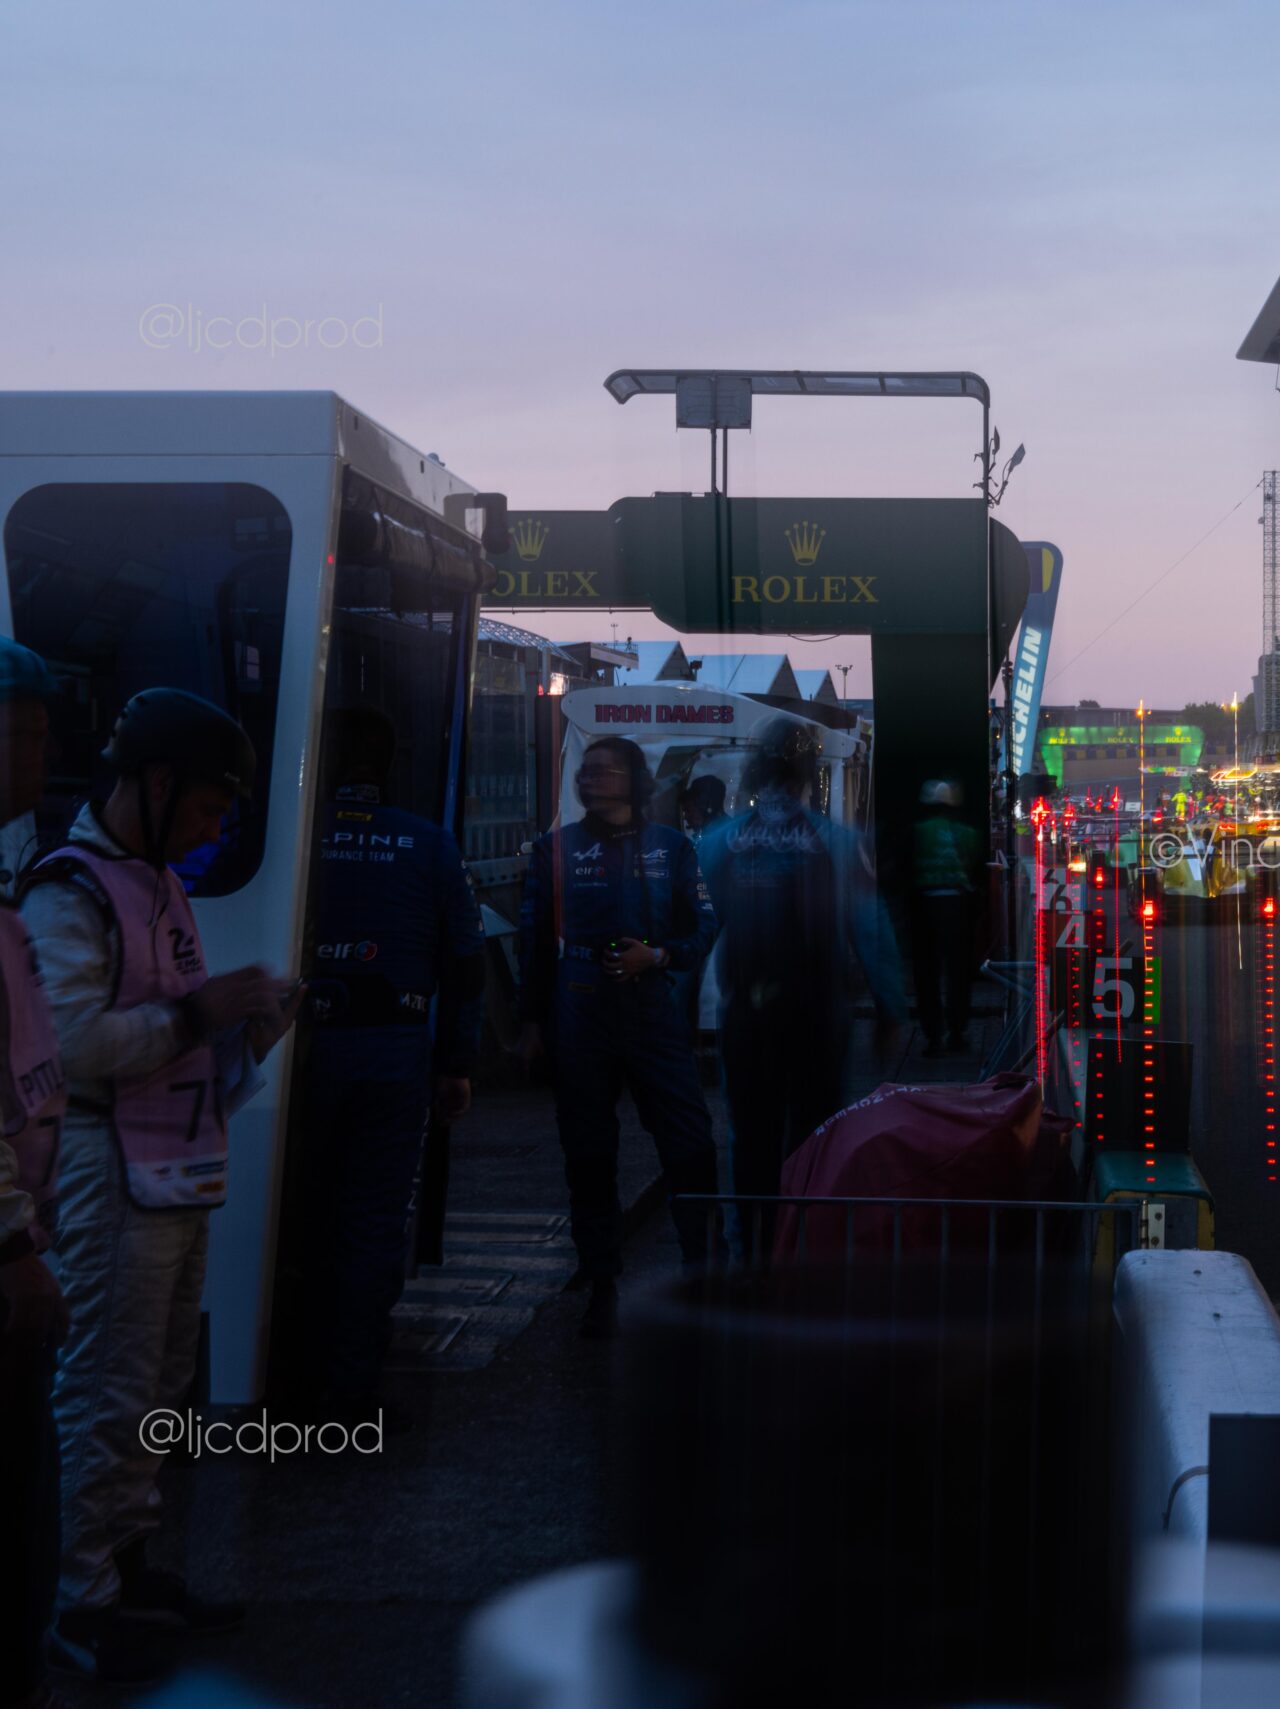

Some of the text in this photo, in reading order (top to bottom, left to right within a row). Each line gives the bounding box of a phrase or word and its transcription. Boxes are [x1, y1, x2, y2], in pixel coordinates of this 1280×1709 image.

[483, 570, 600, 597] OLEX
[731, 575, 878, 604] ROLEX
[595, 704, 735, 724] IRON DAMES
[321, 832, 415, 849] PINE
[368, 851, 396, 862] TEAM
[575, 867, 594, 876] elf
[1056, 912, 1089, 948] 4
[317, 942, 354, 960] elf
[1091, 957, 1135, 1019] 5
